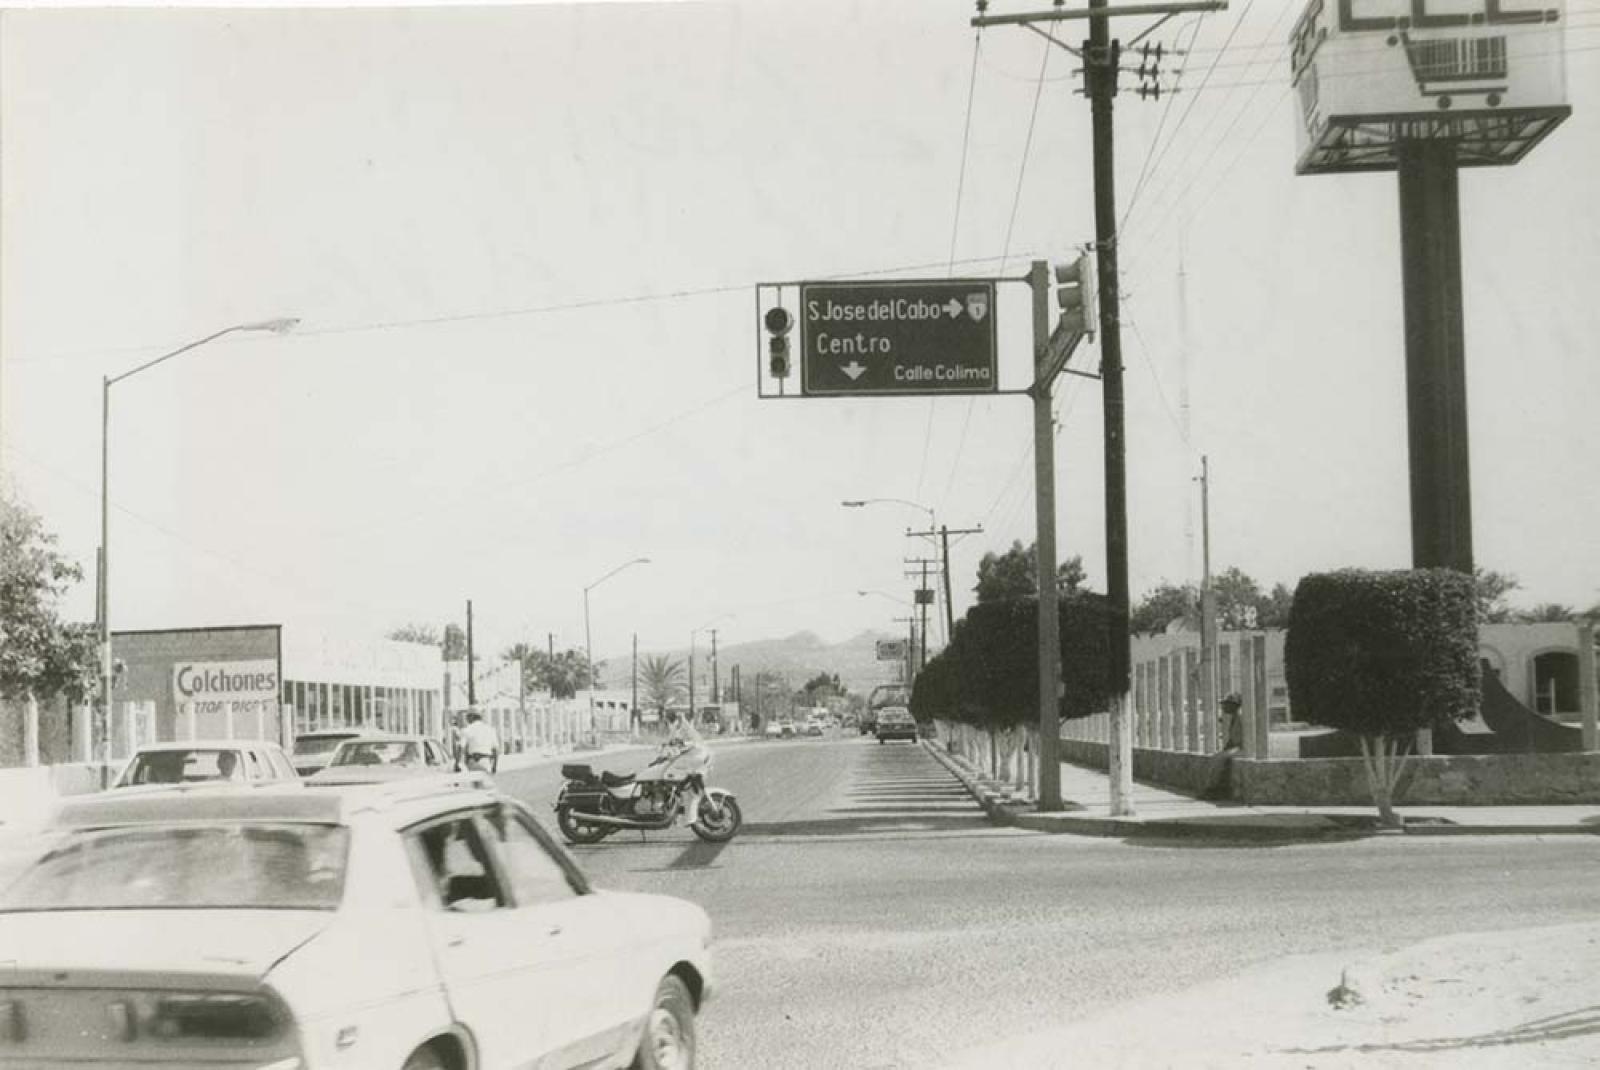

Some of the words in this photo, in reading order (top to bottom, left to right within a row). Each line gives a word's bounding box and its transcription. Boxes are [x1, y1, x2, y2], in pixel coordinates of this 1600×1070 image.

[895, 297, 941, 320] Cabo
[817, 332, 891, 354] Centro
[894, 364, 933, 381] Calle
[935, 363, 990, 381] Colima
[177, 665, 276, 697] Colchones
